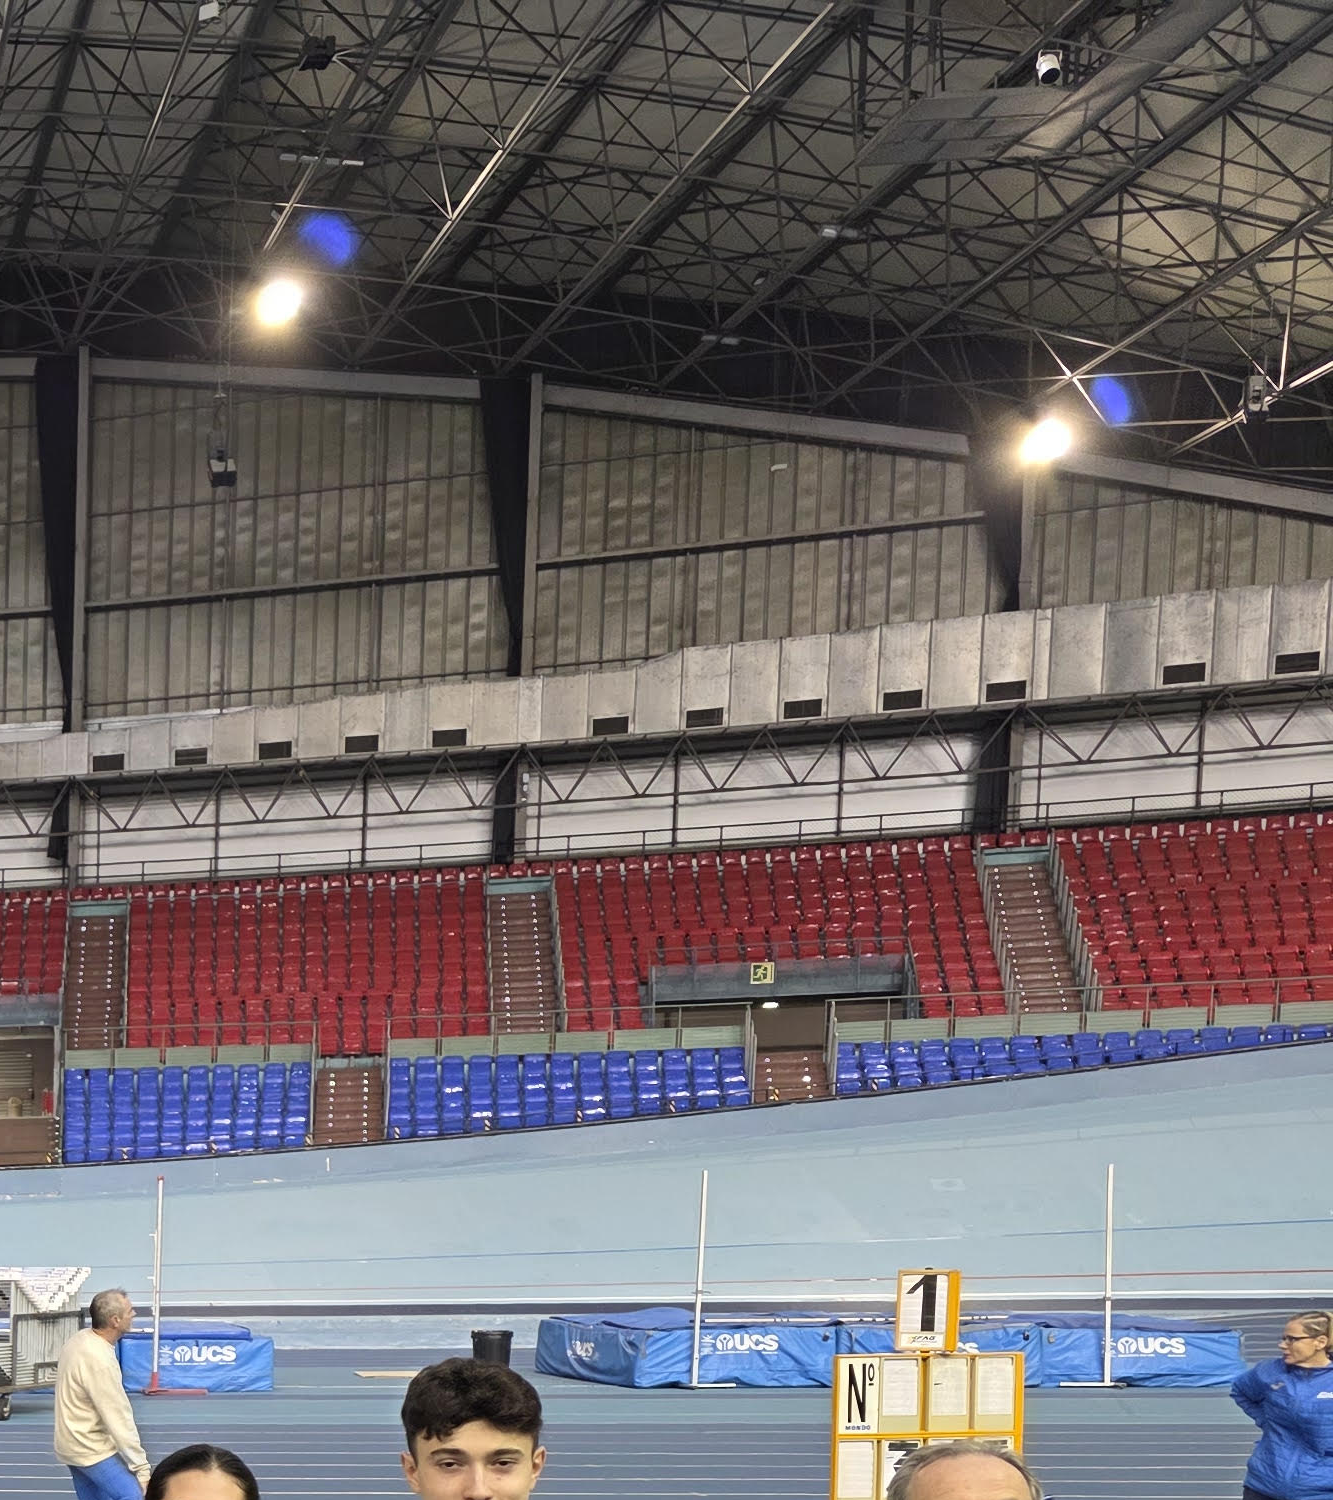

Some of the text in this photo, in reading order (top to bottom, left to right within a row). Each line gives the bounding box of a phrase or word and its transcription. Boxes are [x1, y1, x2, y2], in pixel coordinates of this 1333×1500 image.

[906, 1275, 937, 1332] 1
[734, 1334, 779, 1350] UCS
[1137, 1337, 1186, 1354] UCS
[192, 1345, 237, 1362] UCS
[848, 1363, 876, 1424] Nº
